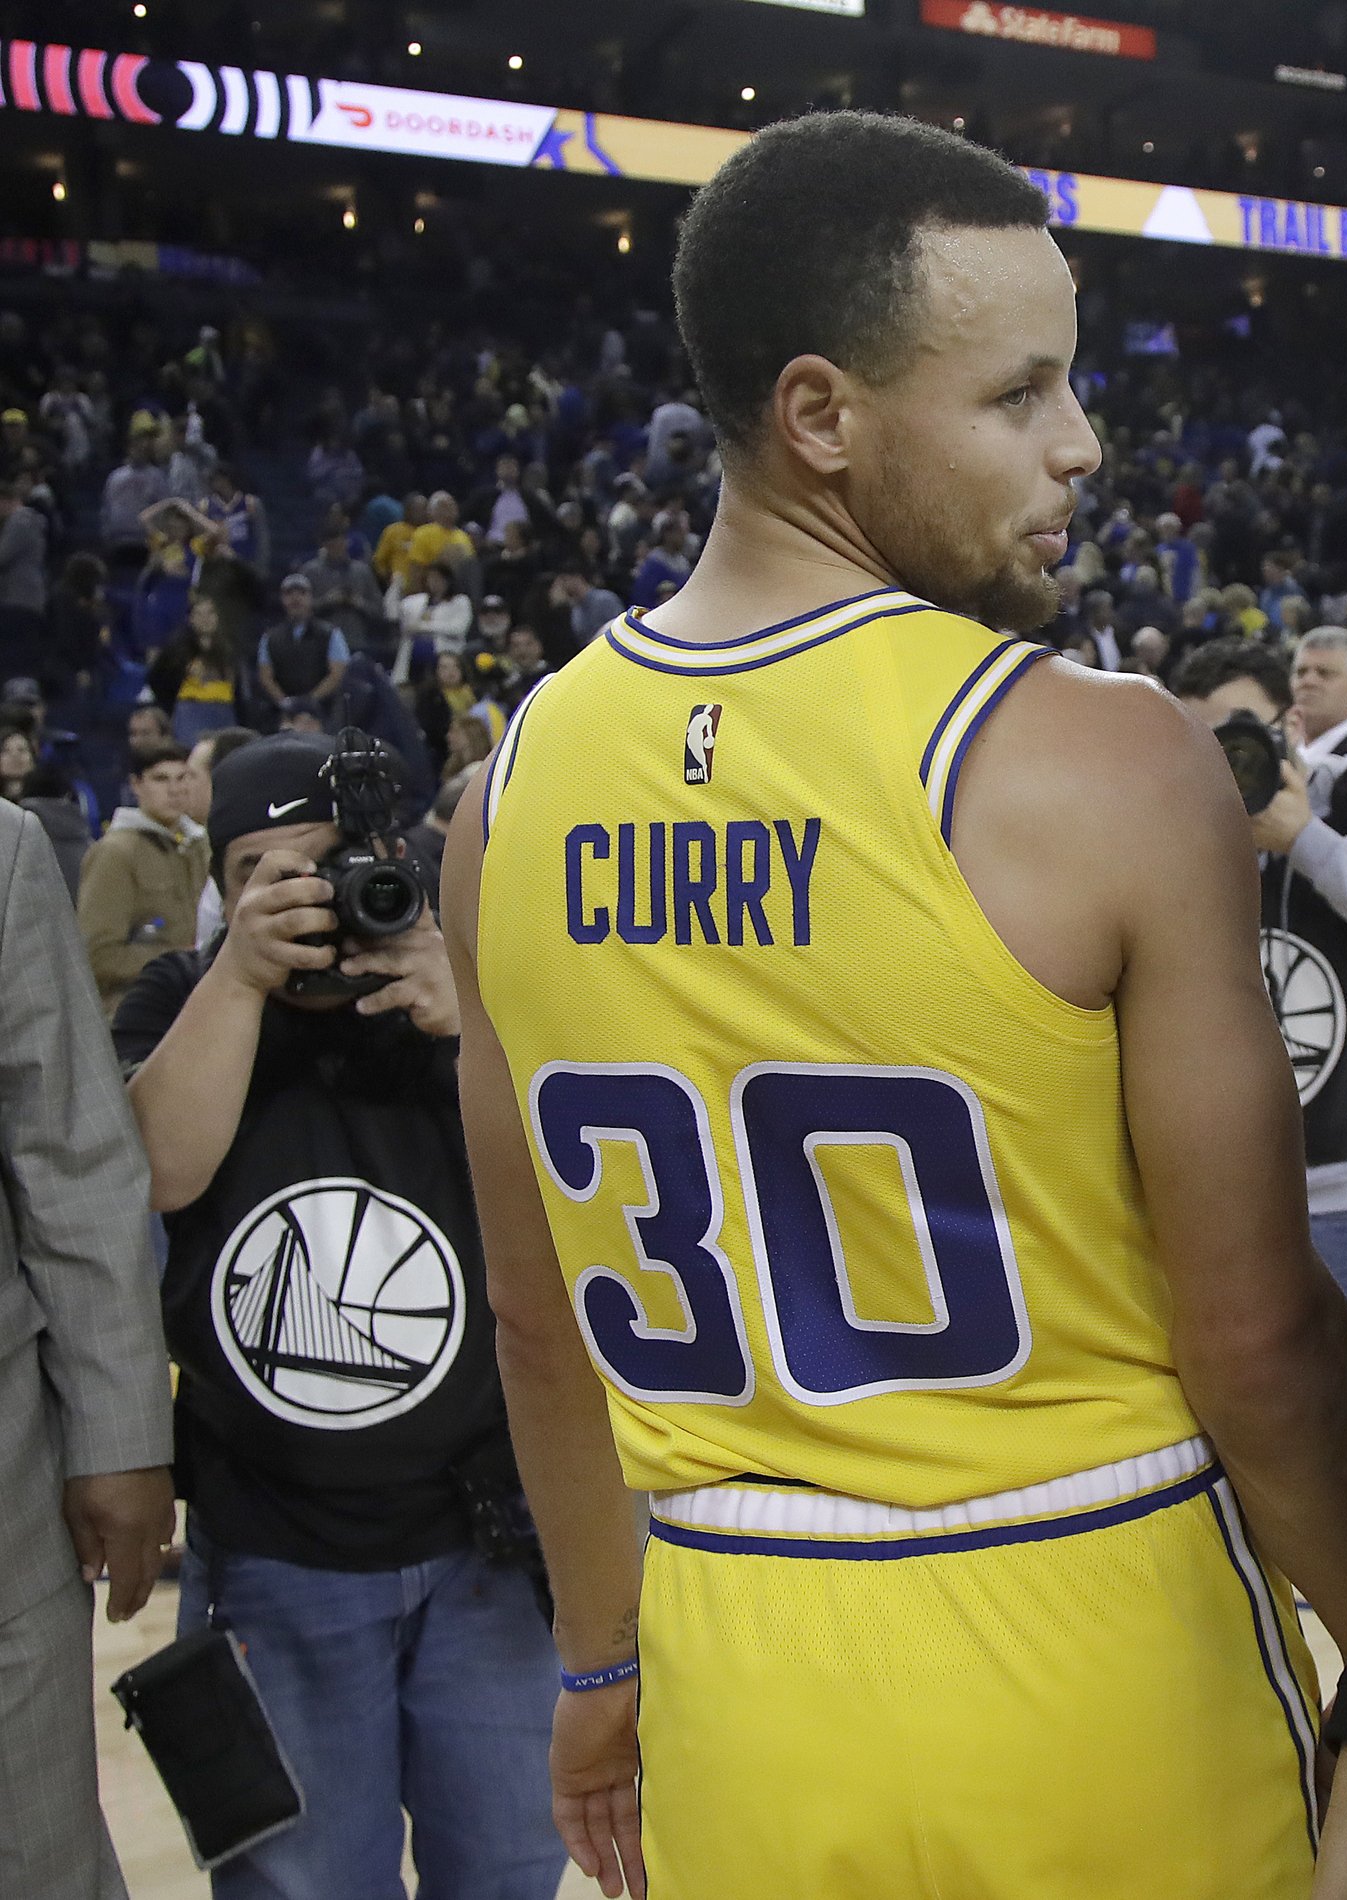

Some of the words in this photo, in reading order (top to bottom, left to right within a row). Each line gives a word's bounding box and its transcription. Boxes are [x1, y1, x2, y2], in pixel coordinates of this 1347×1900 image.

[386, 110, 535, 145] DOORDASH
[1239, 196, 1329, 255] TRAIL
[686, 768, 704, 781] NBA
[564, 817, 822, 947] CURRY
[528, 1059, 1033, 1408] 30
[575, 1675, 604, 1687] PLAY
